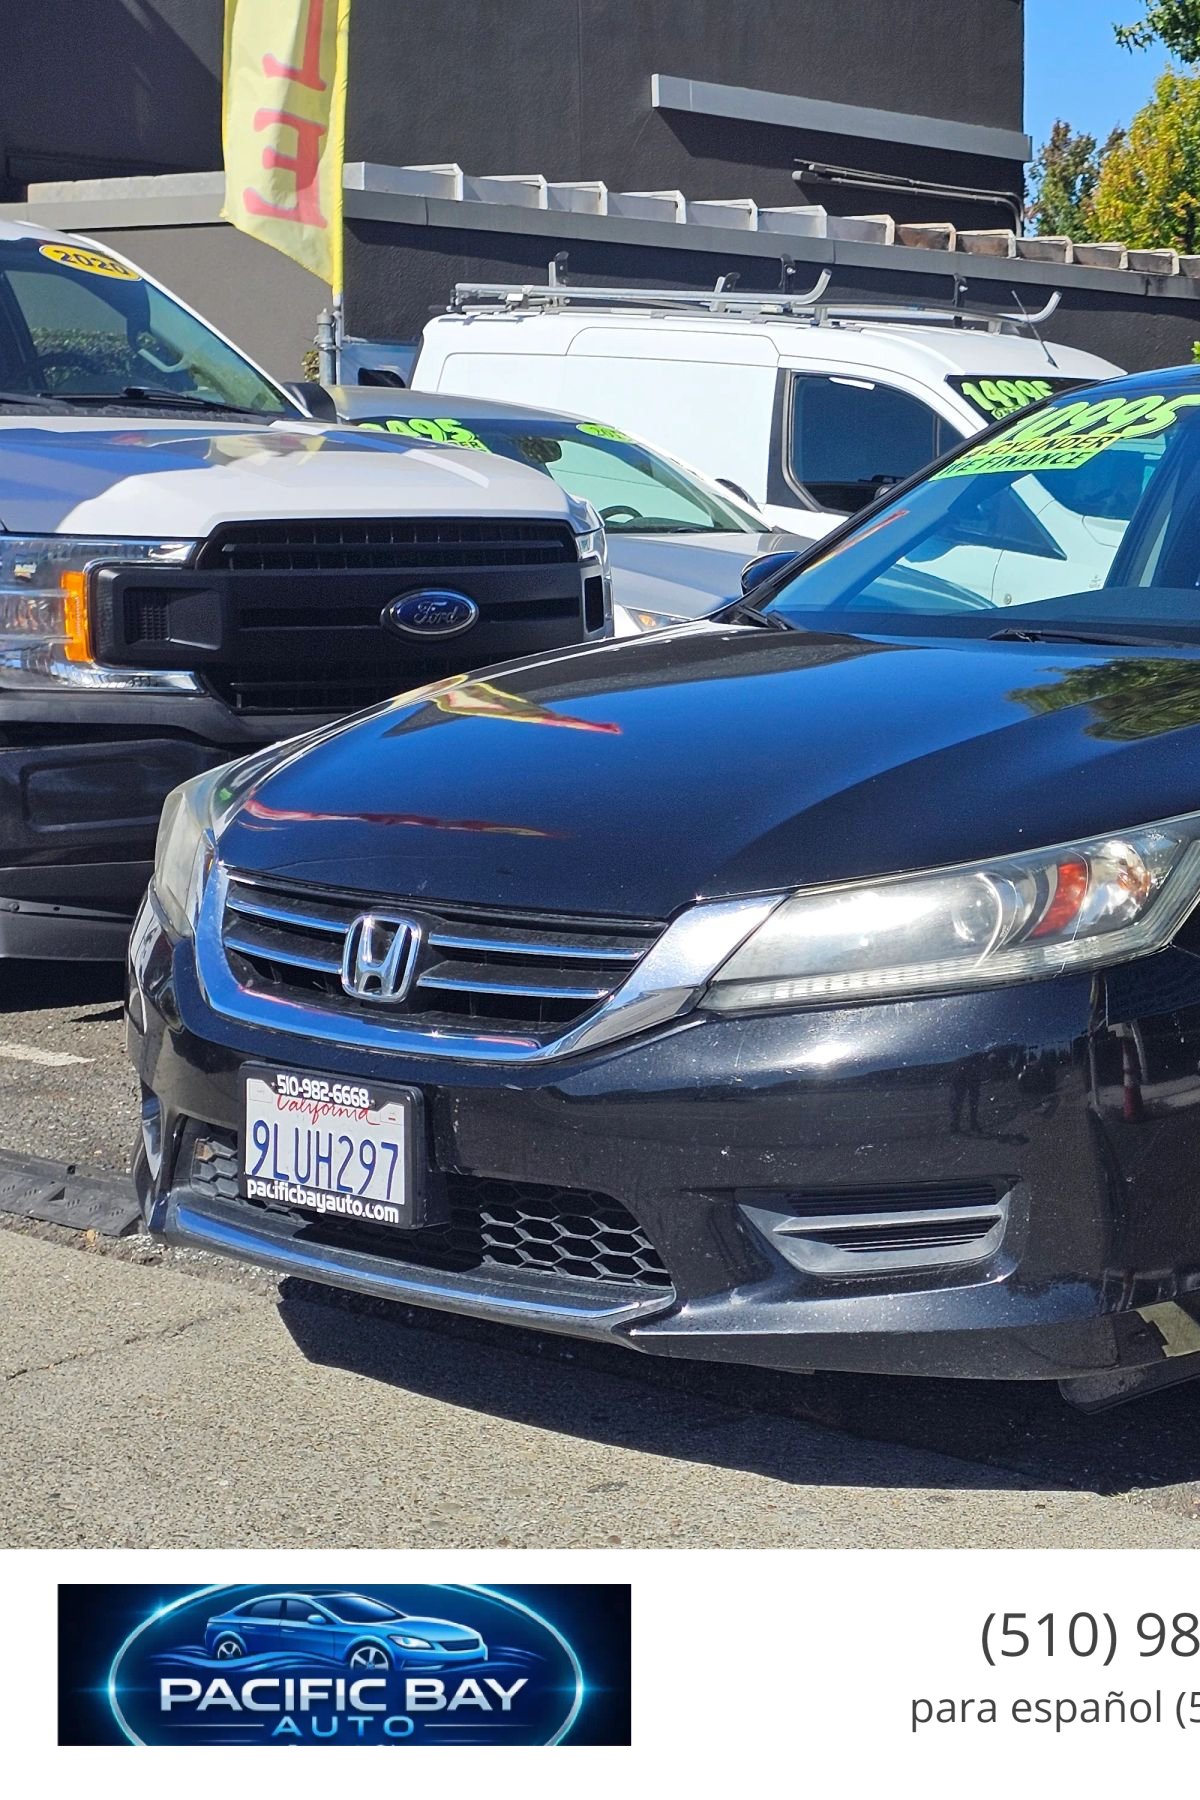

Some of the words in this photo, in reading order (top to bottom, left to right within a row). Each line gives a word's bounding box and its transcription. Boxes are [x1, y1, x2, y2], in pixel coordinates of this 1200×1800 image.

[53, 249, 130, 276] 2020
[974, 451, 1092, 471] FINANCE
[413, 601, 459, 624] Ford
[276, 1074, 370, 1109] 510-982-6668
[276, 1094, 381, 1126] California
[251, 1120, 399, 1201] 9LUH297
[247, 1179, 400, 1224] pacificbayauto.com
